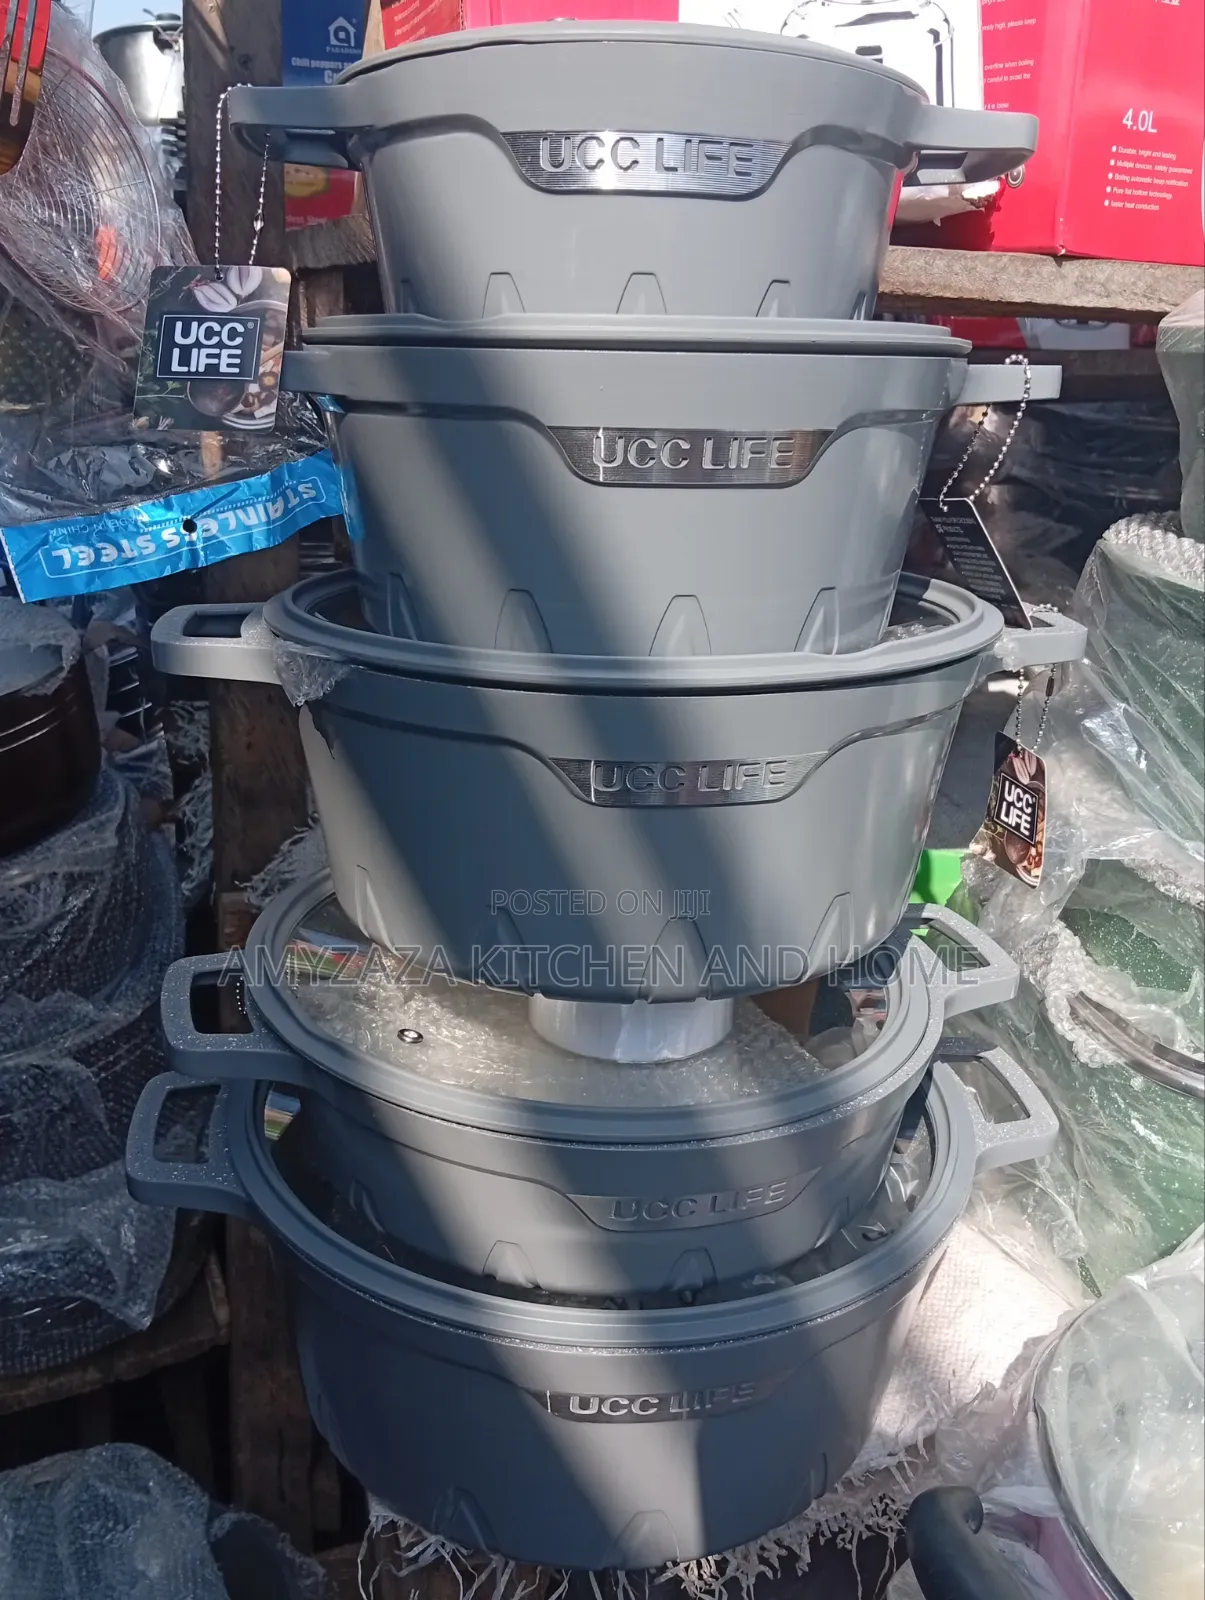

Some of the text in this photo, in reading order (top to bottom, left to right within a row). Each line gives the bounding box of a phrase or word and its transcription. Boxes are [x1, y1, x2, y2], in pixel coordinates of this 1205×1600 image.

[1008, 20, 1023, 28] please
[1024, 18, 1037, 26] keep
[291, 57, 310, 67] Chili
[310, 59, 343, 70] peppers
[984, 58, 1035, 70] overflow when boiling
[1009, 73, 1023, 81] avoid
[1122, 108, 1158, 133] 4.0L
[540, 136, 754, 177] UCC LIFE
[1138, 149, 1152, 157] bright
[1152, 150, 1161, 158] and
[1116, 159, 1134, 169] Multiple
[1154, 164, 1168, 173] safety
[1168, 166, 1193, 174] guaranteed
[1114, 173, 1188, 187] Boiling automatic beep notification
[1110, 199, 1124, 207] faster
[1135, 202, 1159, 211] conduction
[171, 348, 242, 373] LIFE
[593, 435, 795, 470] UCC LIFE
[49, 523, 90, 536] CHINA
[52, 534, 156, 569] STEEL
[594, 760, 787, 792] UCC LIFE
[1000, 802, 1031, 836] LIFE
[608, 1181, 787, 1222] UCC LIFE
[569, 1382, 755, 1416] UCC LIFE
